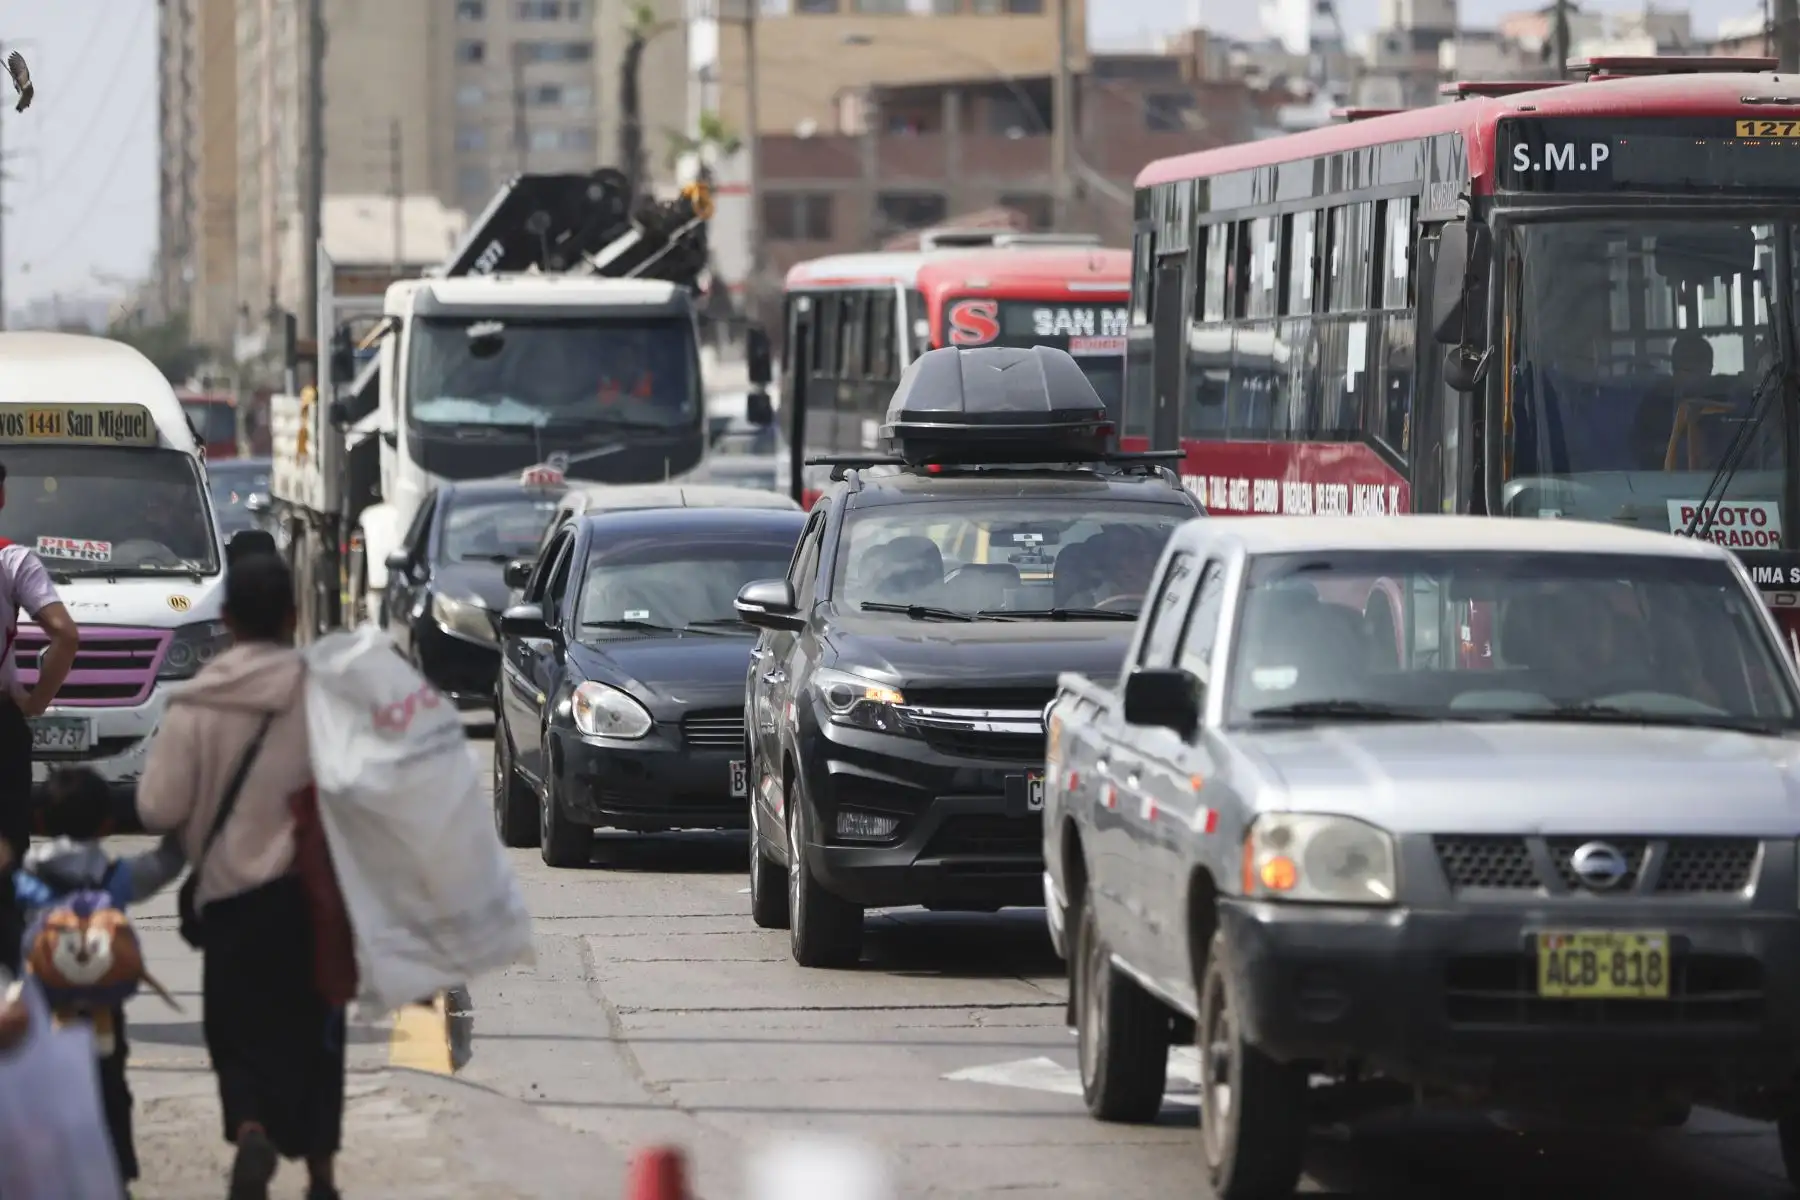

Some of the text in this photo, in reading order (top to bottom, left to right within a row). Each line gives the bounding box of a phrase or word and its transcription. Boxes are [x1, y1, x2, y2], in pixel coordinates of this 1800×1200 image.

[1741, 121, 1800, 136] 127
[1513, 142, 1609, 172] S.M.P
[950, 299, 1000, 345] S
[1033, 308, 1095, 336] SAN
[28, 411, 61, 434] 1441
[67, 411, 94, 437] San
[98, 411, 147, 441] Miguel
[1680, 506, 1767, 526] PILOTO
[39, 538, 109, 552] PILAS
[1750, 567, 1784, 583] IMA
[1547, 950, 1663, 987] ACB-818
